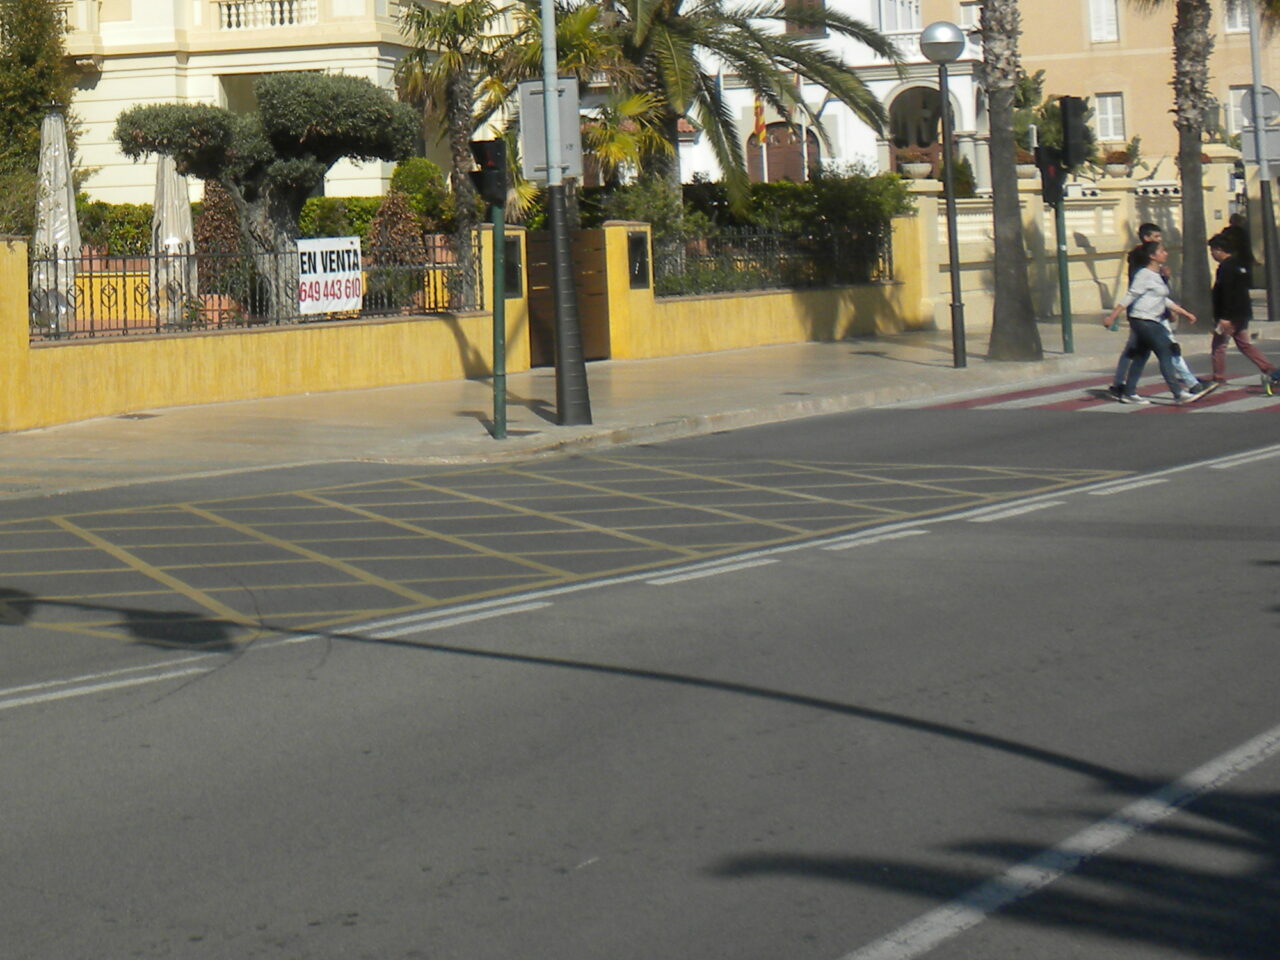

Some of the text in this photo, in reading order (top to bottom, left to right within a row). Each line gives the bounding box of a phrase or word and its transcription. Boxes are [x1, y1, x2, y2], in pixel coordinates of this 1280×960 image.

[300, 249, 360, 275] EN VENTA
[299, 277, 361, 303] 649 443 610
